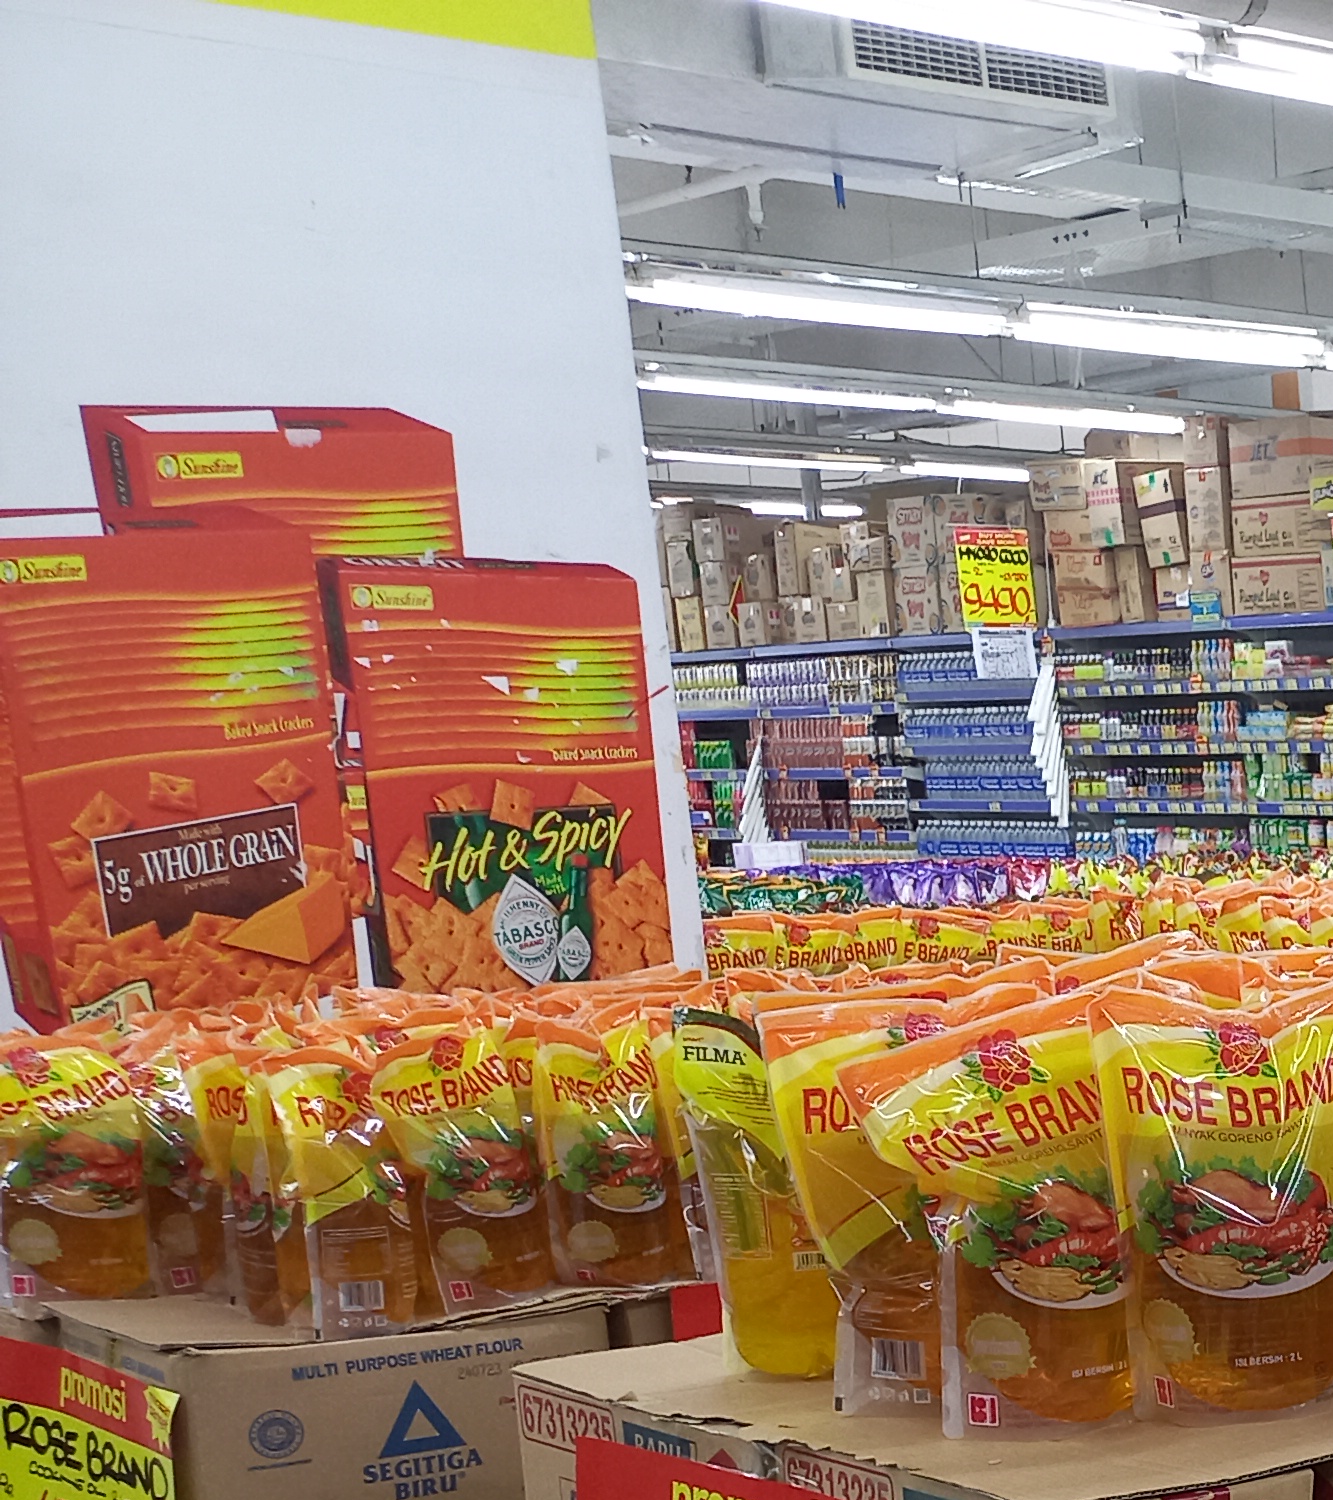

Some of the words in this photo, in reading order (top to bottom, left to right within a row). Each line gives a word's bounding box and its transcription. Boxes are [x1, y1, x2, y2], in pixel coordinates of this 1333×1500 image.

[182, 455, 240, 478] Sunshine
[22, 558, 83, 581] Sunshine
[375, 587, 432, 609] Sunshine
[252, 719, 279, 738] Snack
[280, 715, 315, 734] Crackers
[604, 745, 639, 759] Crackers
[104, 859, 132, 903] 5g
[140, 840, 227, 888] WHOLE
[229, 823, 297, 873] GRAIN
[424, 828, 495, 893] Hot
[500, 829, 532, 872] &
[532, 808, 632, 872] Spicy
[494, 916, 562, 947] TABASCO
[707, 948, 767, 972] BRAND
[917, 941, 969, 961] BRAND
[682, 1044, 745, 1067] FILMA
[382, 1075, 441, 1118] ROSE
[1122, 1064, 1218, 1129] ROSE
[902, 1111, 998, 1176] ROSE
[1214, 1130, 1275, 1144] GORENG
[291, 1363, 339, 1382] MULTI
[345, 1353, 417, 1376] PURPOSE
[418, 1345, 473, 1367] WHEAT
[474, 1337, 524, 1360] FLOUR
[60, 1366, 127, 1423] promosi
[2, 1402, 85, 1472] ROSE
[363, 1448, 484, 1485] SEGITIGA
[394, 1474, 459, 1500] BIRU
